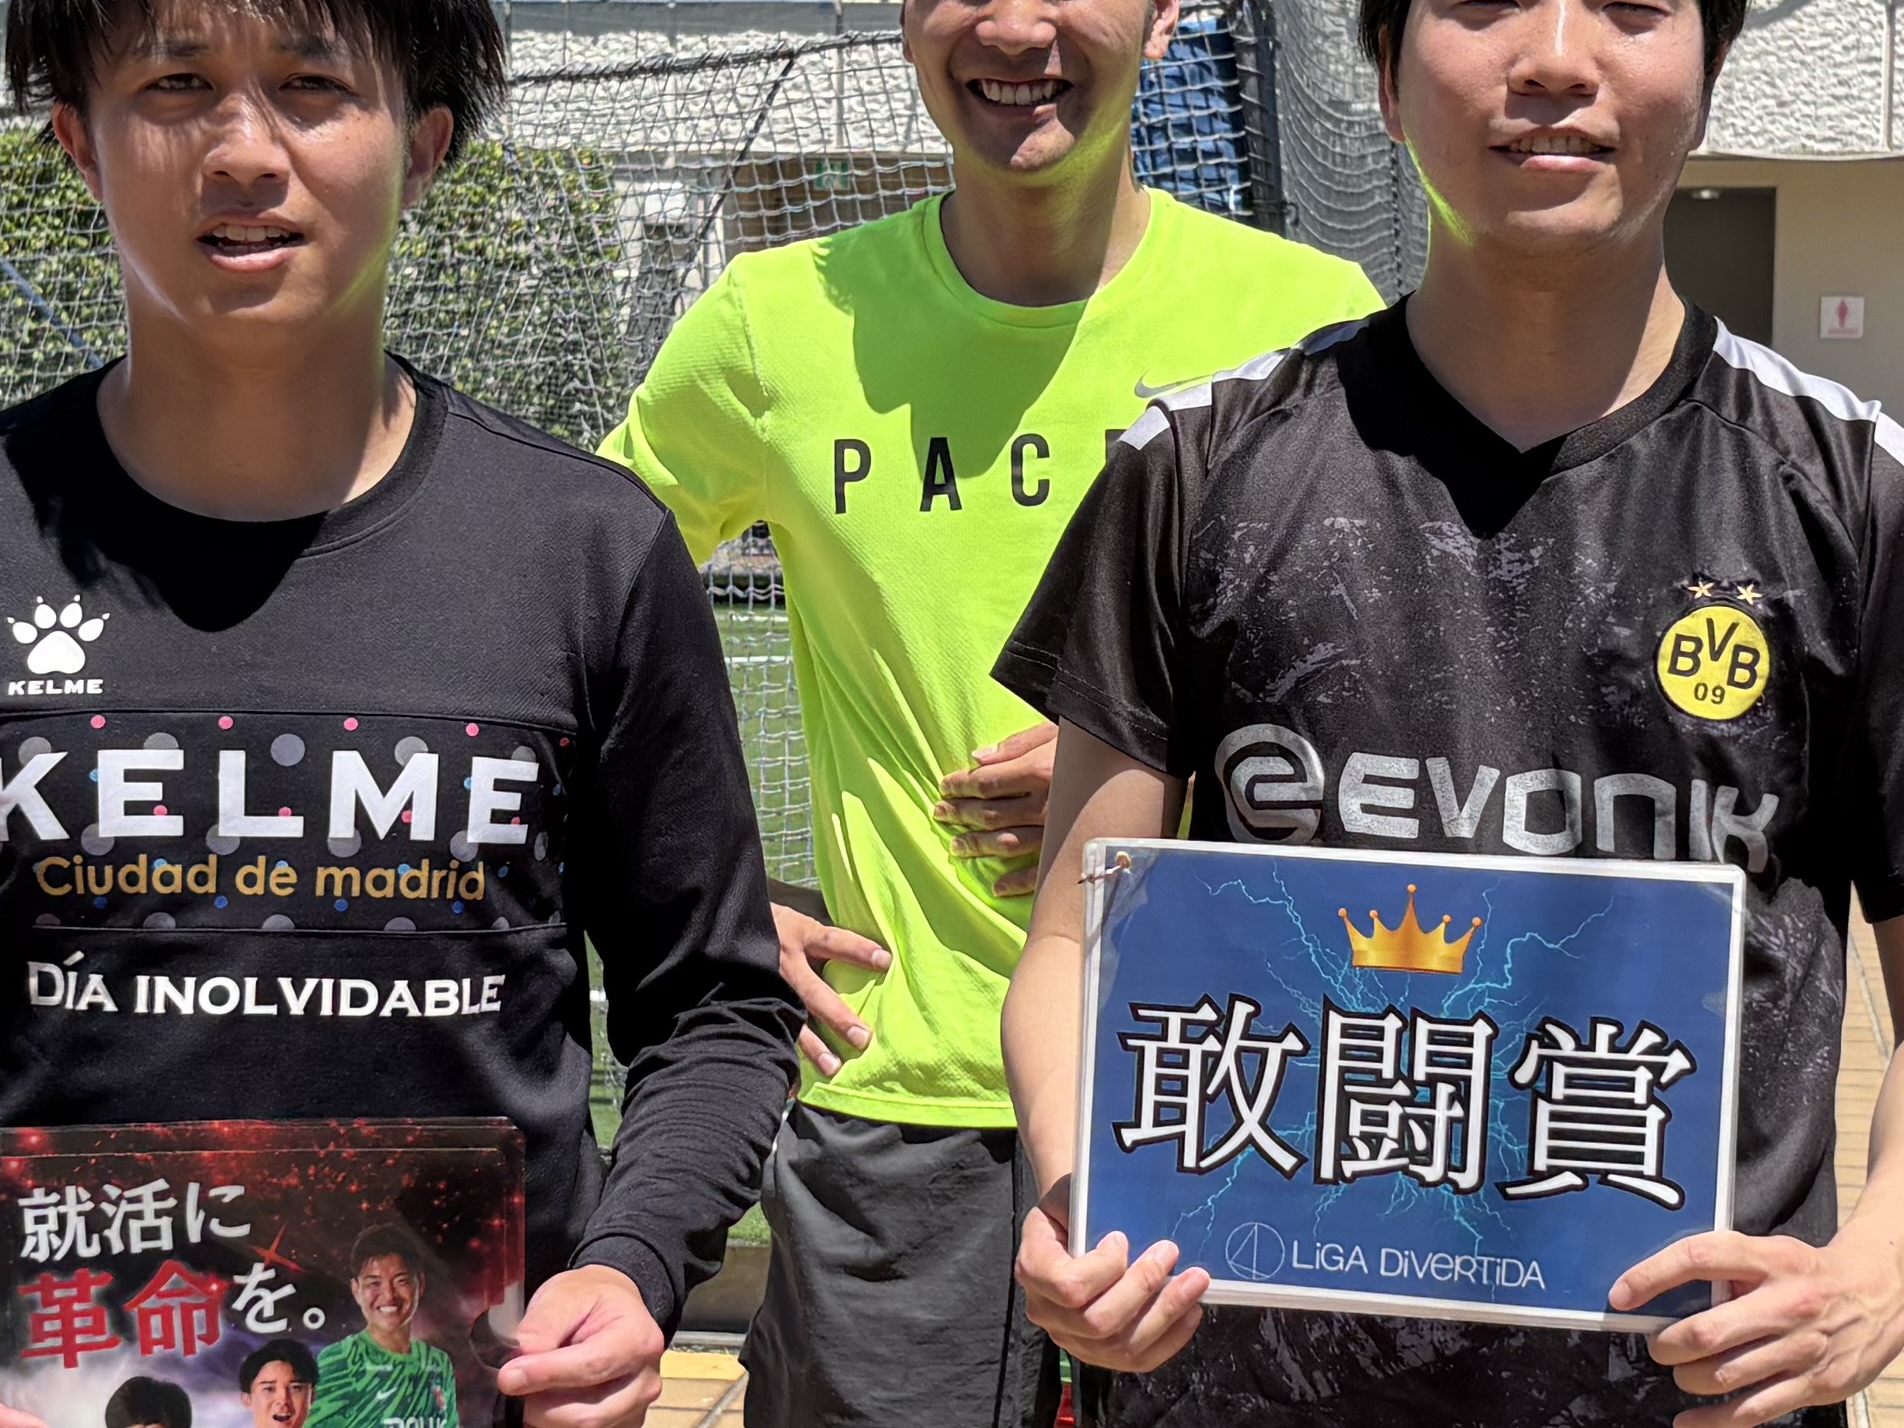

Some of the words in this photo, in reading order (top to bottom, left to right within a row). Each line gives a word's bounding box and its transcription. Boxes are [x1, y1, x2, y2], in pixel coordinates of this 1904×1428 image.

[834, 429, 1128, 515] PAC
[7, 678, 104, 695] KELME
[1667, 617, 1761, 693] BVB
[1693, 683, 1727, 706] 09
[36, 854, 218, 897] Ciudad
[234, 856, 298, 897] de
[314, 858, 485, 901] madrid
[28, 952, 118, 1011] DÍA
[134, 974, 506, 1017] INOLVIDABLE
[1112, 993, 1697, 1211] 敢闘賞
[17, 1177, 251, 1263] 就活に
[1291, 1239, 1368, 1275] LiGA
[17, 1258, 328, 1369] 革命を。
